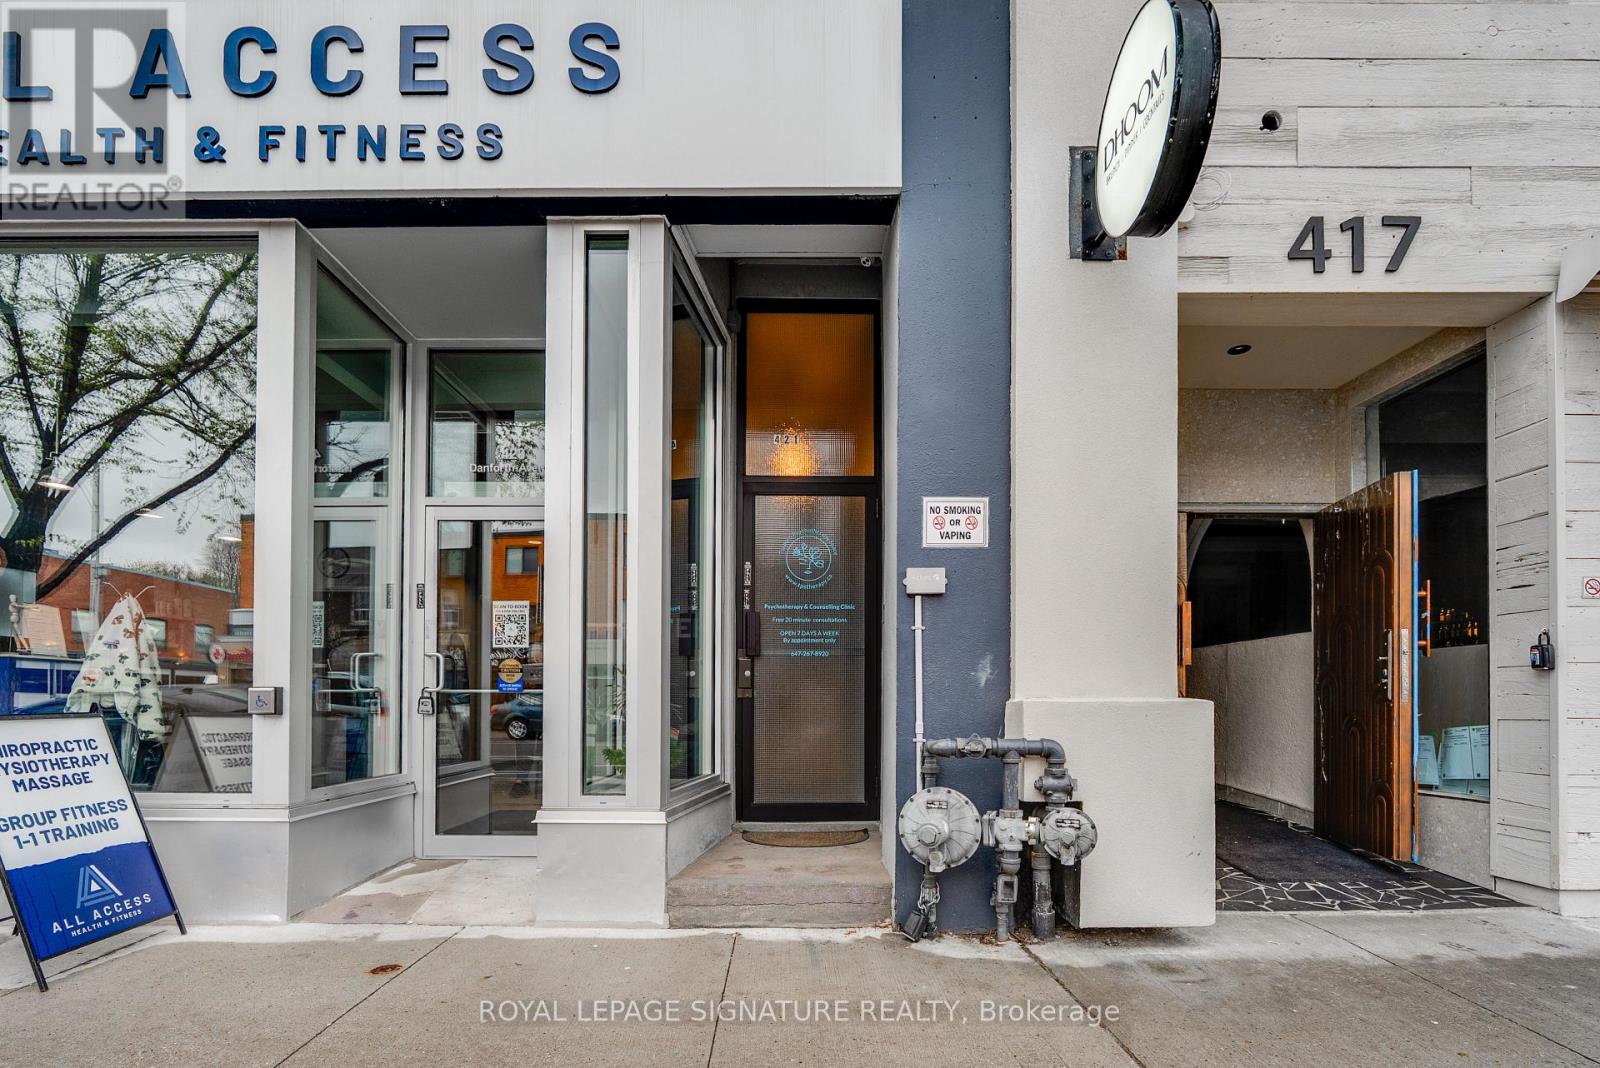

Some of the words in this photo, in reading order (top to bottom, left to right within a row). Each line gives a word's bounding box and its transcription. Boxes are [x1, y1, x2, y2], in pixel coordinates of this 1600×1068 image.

[129, 22, 621, 99] ACCESS
[1104, 45, 1168, 173] DHOOM
[193, 126, 226, 164] &
[258, 122, 503, 163] FITNESS
[1287, 215, 1422, 274] 417
[774, 434, 799, 445] 421
[929, 506, 941, 515] NO
[944, 505, 982, 515] SMOKING
[949, 519, 961, 527] OR
[939, 531, 972, 540] VAPING
[12, 771, 93, 793] MASSAGE
[0, 810, 57, 833] GROUP
[60, 799, 128, 821] FITNESS
[13, 832, 38, 849] 1-1
[39, 817, 119, 844] TRAINING
[52, 915, 85, 933] ALL
[93, 893, 151, 920] ACCESS
[71, 922, 102, 937] HEALTH
[111, 909, 142, 923] FITNESS
